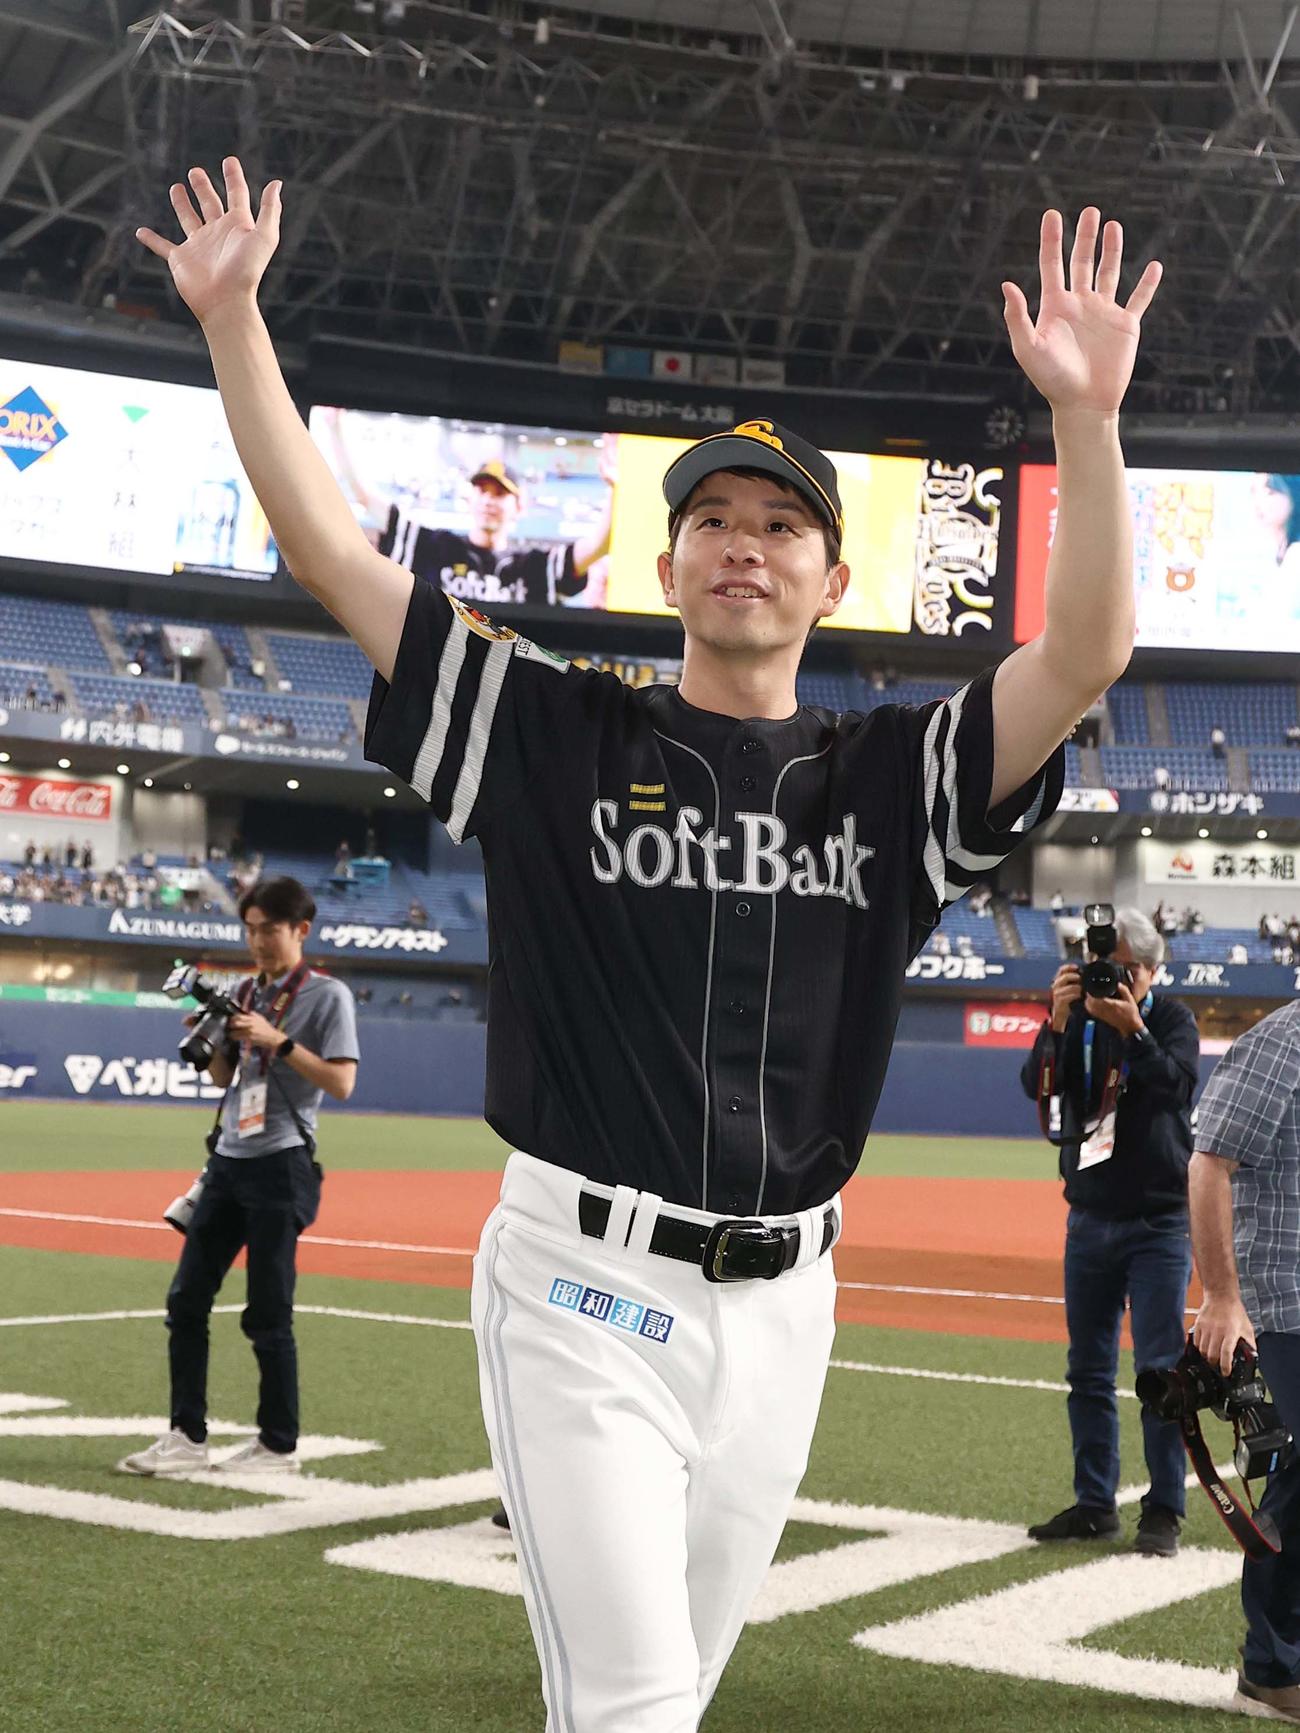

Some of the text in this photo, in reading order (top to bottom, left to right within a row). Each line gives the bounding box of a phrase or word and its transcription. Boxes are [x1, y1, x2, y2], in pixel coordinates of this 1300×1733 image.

[0, 408, 57, 442] ORIX
[589, 798, 877, 910] SoftBank
[1212, 853, 1295, 881] 森本組
[551, 1280, 671, 1342] 昭和建設
